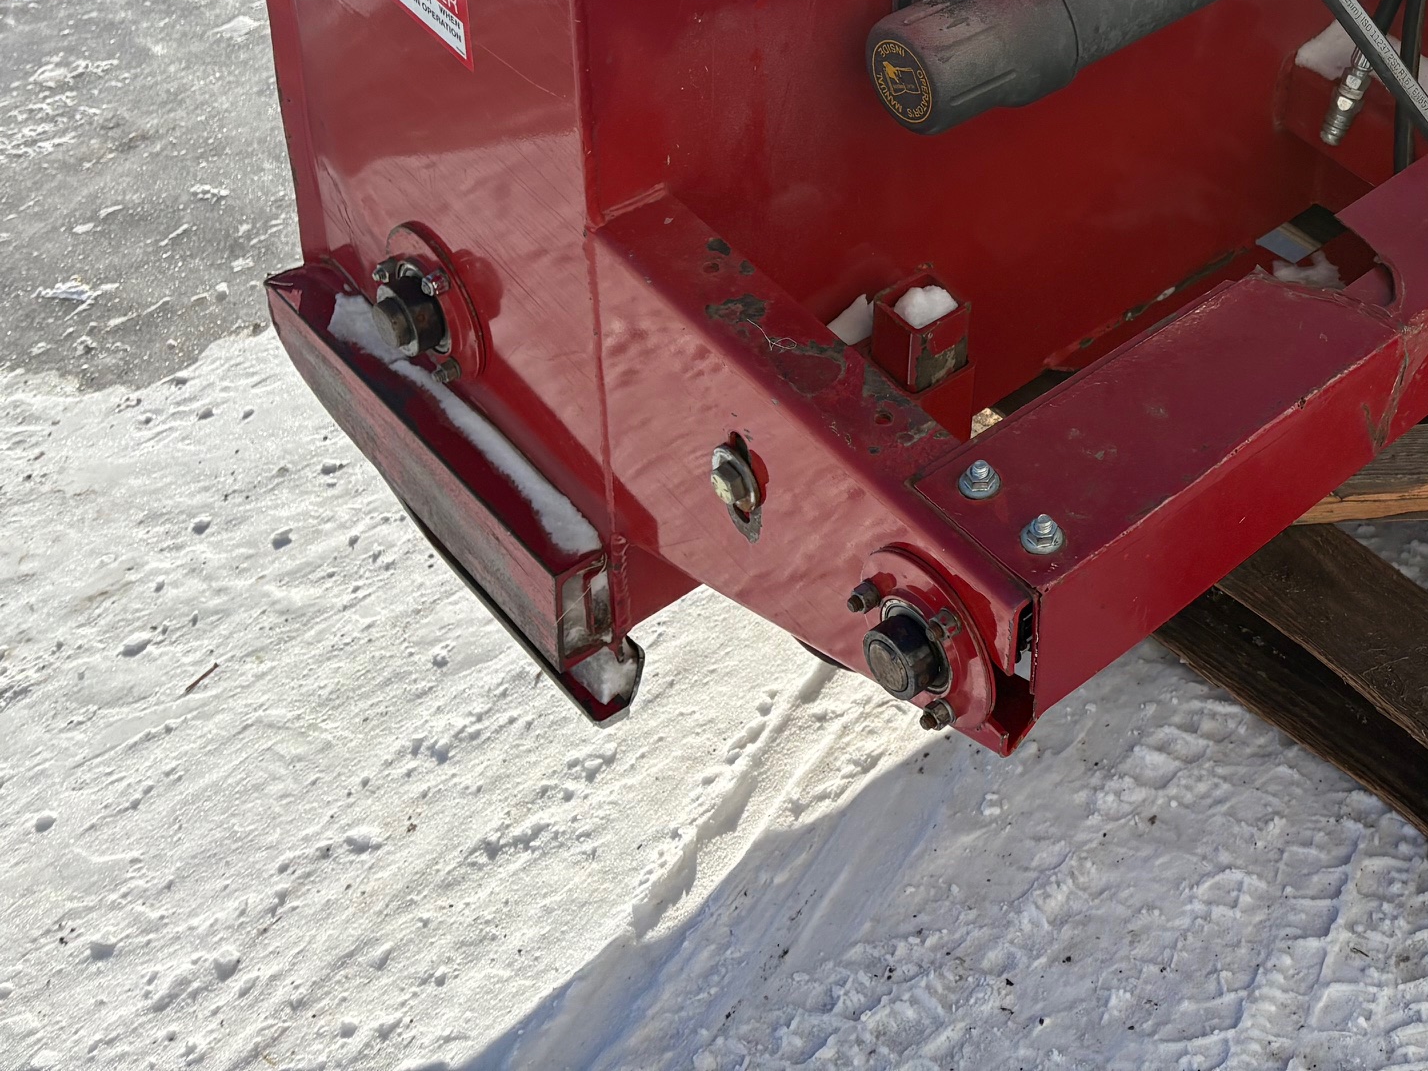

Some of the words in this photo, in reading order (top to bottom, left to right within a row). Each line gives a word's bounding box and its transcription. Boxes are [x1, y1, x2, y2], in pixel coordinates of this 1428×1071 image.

[422, 2, 463, 43] OPERATION
[439, 4, 462, 30] WHEN
[1360, 15, 1374, 33] ISO
[1369, 29, 1391, 55] 11237
[877, 44, 905, 58] INSIDE
[877, 73, 903, 113] MANUAL
[907, 70, 929, 118] OPERATOR'S
